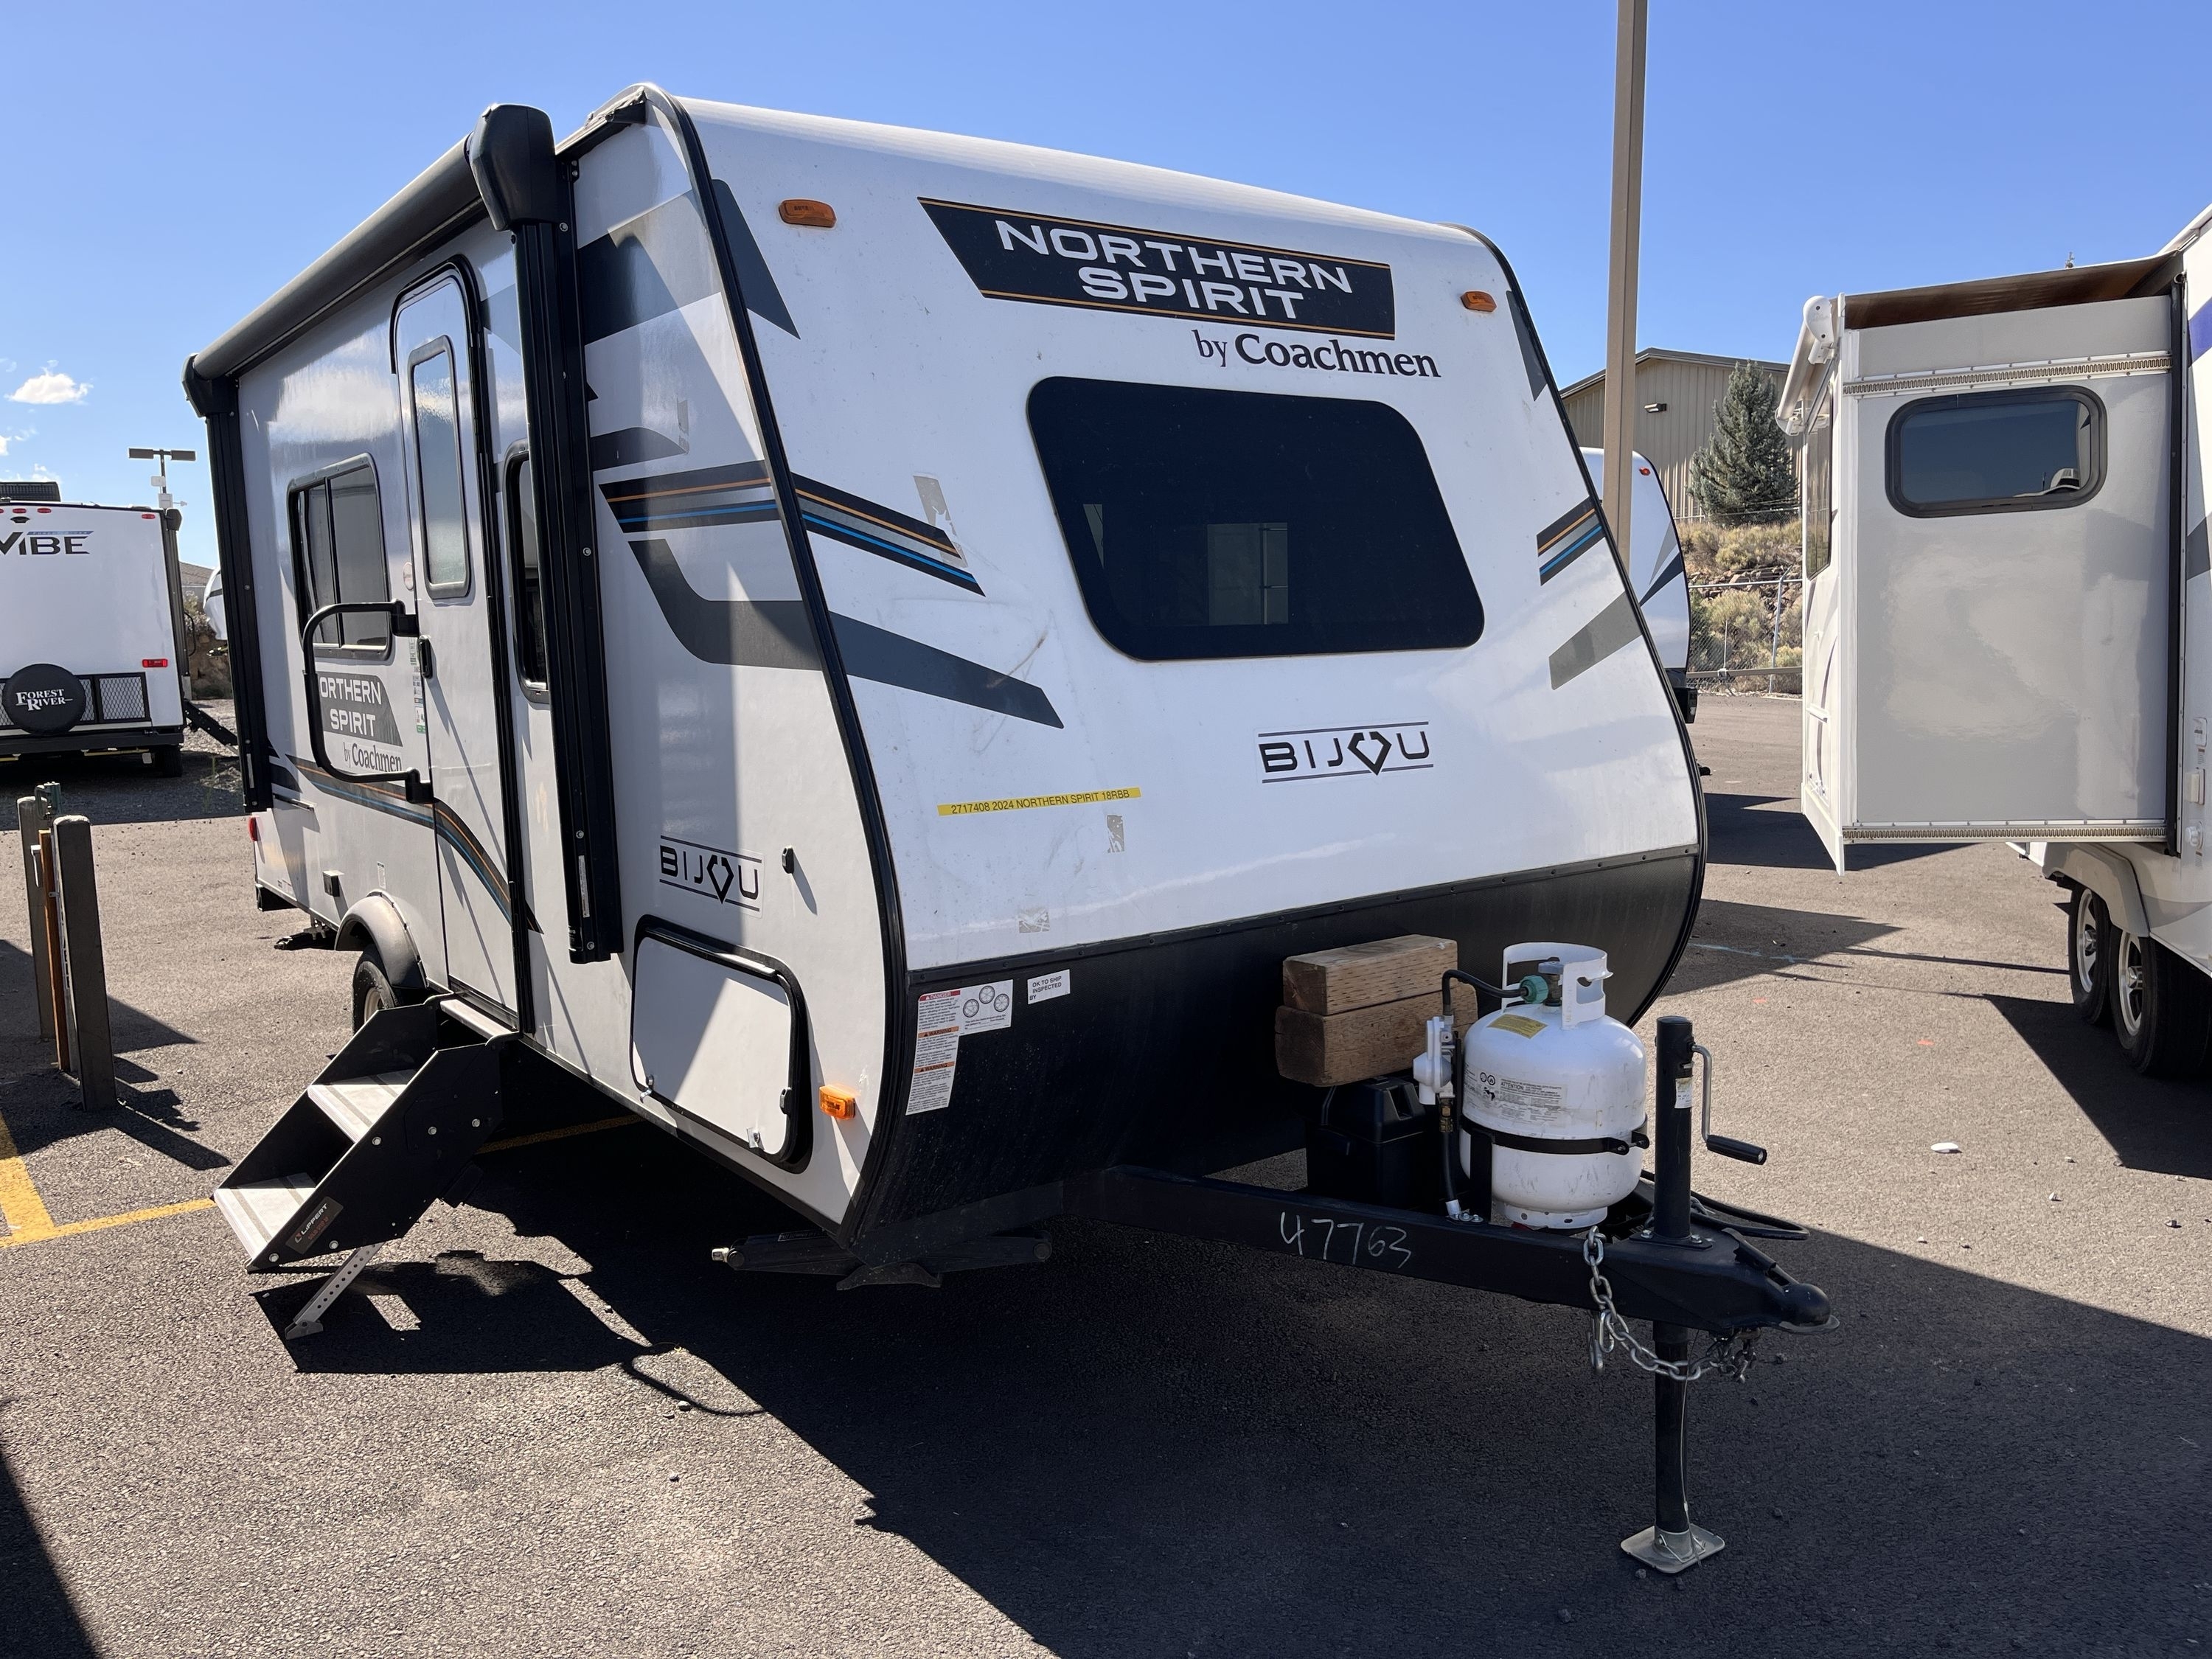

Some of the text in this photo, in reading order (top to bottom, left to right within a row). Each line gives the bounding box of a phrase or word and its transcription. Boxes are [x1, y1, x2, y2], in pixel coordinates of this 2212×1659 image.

[995, 220, 1352, 293] NORTHERN
[1078, 267, 1304, 319] SPIRIT
[1192, 330, 1441, 378] by Coachmen
[15, 689, 64, 706] FOREST
[27, 697, 66, 711] RIVER
[319, 677, 382, 705] ORTHERN
[330, 709, 376, 737] SPIRIT
[343, 742, 403, 773] by Coachmen
[1258, 731, 1430, 776] BIJOU
[951, 789, 1130, 815] 2717408 2024 NORTHERN SPIRIT 18RBB
[660, 845, 759, 904] BIJOU
[930, 992, 951, 1001] DANGER
[1032, 981, 1062, 994] INSPECTED
[929, 1027, 952, 1037] WARNING
[925, 1062, 948, 1071] WARNING
[301, 1203, 327, 1235] LIPPERT
[1280, 1211, 1412, 1269] 47763
